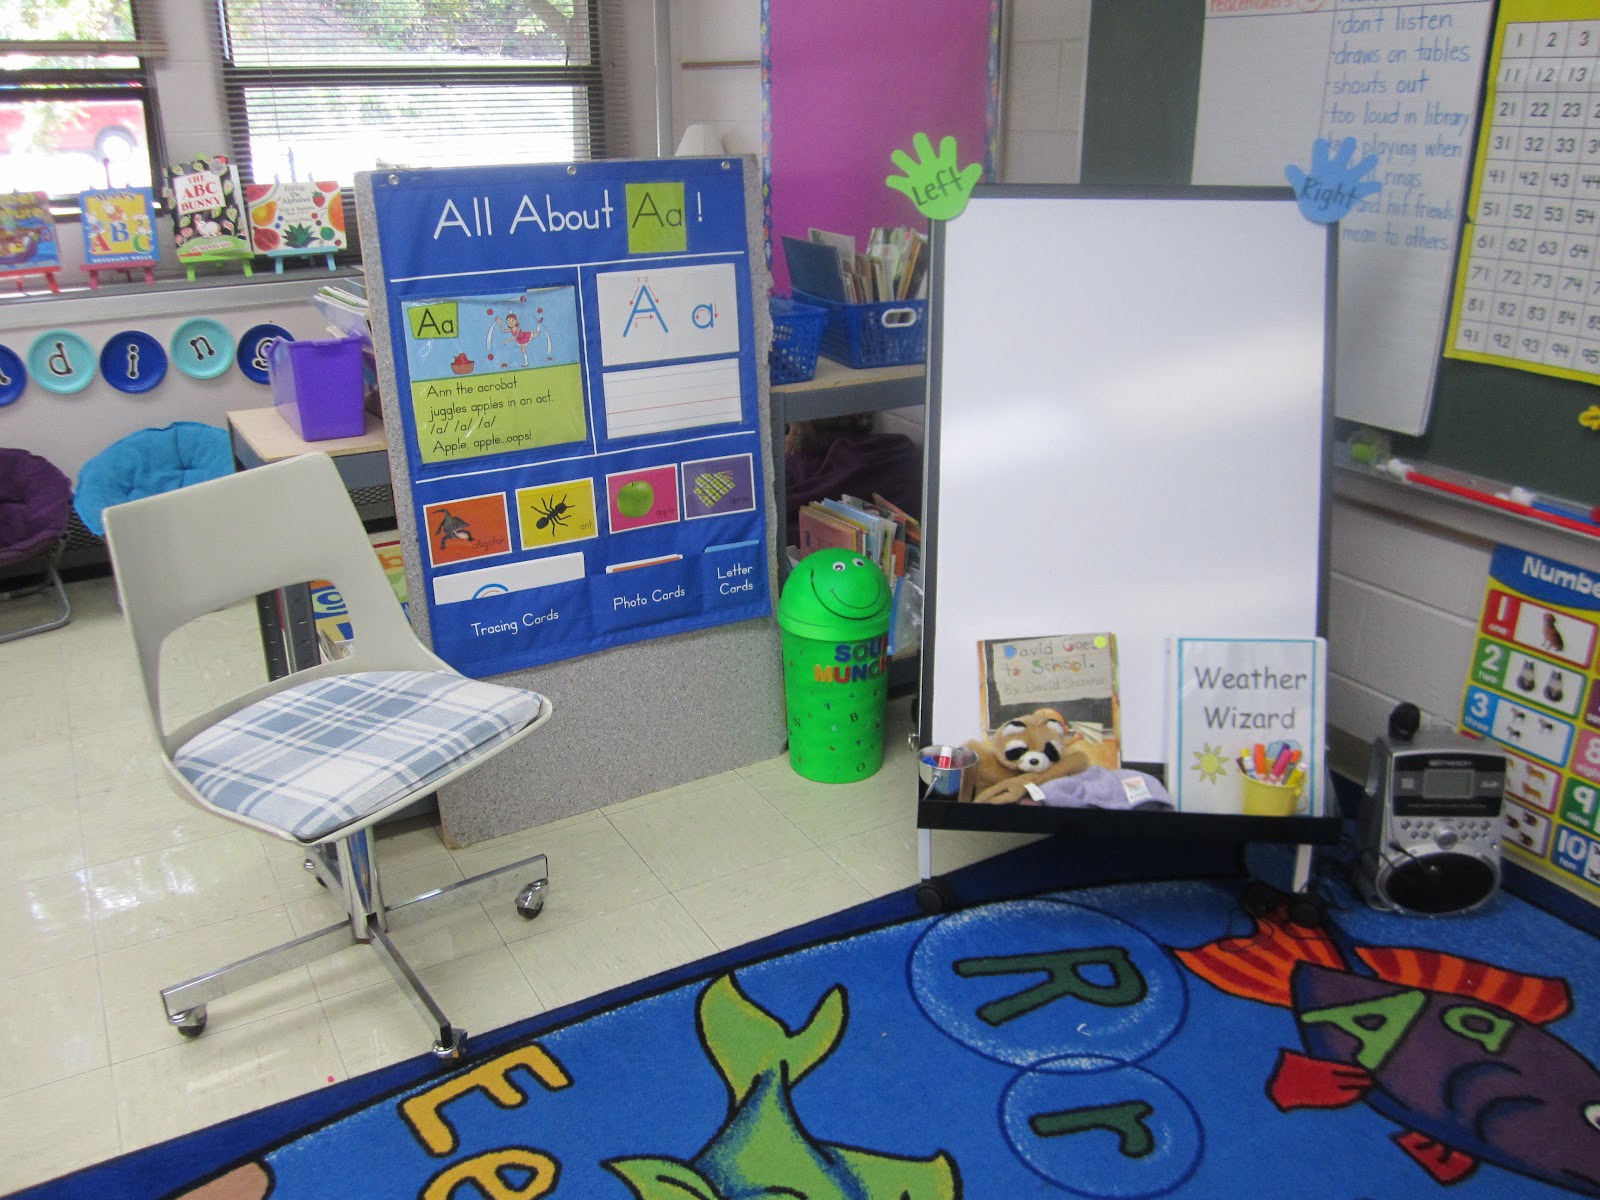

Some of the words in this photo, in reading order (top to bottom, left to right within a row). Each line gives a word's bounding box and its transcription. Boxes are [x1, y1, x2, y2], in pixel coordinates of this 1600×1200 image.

[1395, 6, 1453, 31] listen
[1334, 41, 1380, 64] draws
[1387, 49, 1406, 63] on
[1415, 37, 1470, 62] tables
[1516, 33, 1523, 47] 1
[1546, 32, 1558, 47] 2
[1579, 31, 1590, 46] 3
[1330, 71, 1387, 94] shouts
[1396, 70, 1429, 94] out
[1504, 68, 1520, 82] 11
[1535, 68, 1555, 82] 12
[1568, 68, 1588, 82] 13
[1330, 103, 1355, 124] too
[1363, 101, 1399, 124] loud
[1403, 111, 1416, 124] in
[1425, 101, 1470, 136] library
[1499, 102, 1516, 116] 21
[1530, 102, 1549, 117] 22
[1561, 102, 1581, 117] 23
[1362, 132, 1417, 167] playing
[1425, 133, 1462, 157] when
[1494, 136, 1511, 150] 31
[1524, 137, 1544, 151] 32
[1555, 138, 1575, 152] 33
[183, 181, 217, 199] ABC
[188, 174, 205, 184] THE
[911, 166, 963, 206] Left
[1488, 169, 1506, 183] 41
[1518, 171, 1538, 186] 42
[1549, 173, 1569, 188] 43
[1582, 174, 1600, 189] 44
[181, 197, 222, 211] BUNNY
[1302, 177, 1358, 210] Right
[433, 198, 493, 240] All
[509, 189, 614, 235] About
[632, 191, 683, 229] Aa
[1482, 202, 1500, 216] 51
[1513, 204, 1533, 220] 52
[1544, 207, 1563, 222] 53
[1576, 209, 1595, 224] 54
[1477, 235, 1495, 249] 61
[1507, 239, 1527, 253] 62
[1538, 241, 1558, 255] 63
[1569, 244, 1588, 259] 64
[1471, 266, 1489, 281] 71
[1502, 270, 1521, 285] 72
[1532, 273, 1552, 288] 73
[1563, 277, 1582, 292] 74
[417, 308, 454, 337] Aa
[622, 285, 669, 337] A
[691, 303, 715, 330] a
[1467, 299, 1484, 313] 81
[1497, 302, 1516, 317] 82
[1527, 306, 1545, 321] 83
[1557, 311, 1576, 325] 84
[1463, 330, 1480, 343] 91
[1493, 334, 1511, 349] 92
[1522, 338, 1540, 353] 93
[1552, 343, 1569, 358] 94
[1582, 348, 1600, 364] 95
[427, 385, 452, 398] Ann
[456, 382, 474, 395] the
[477, 376, 517, 393] acrobat
[429, 402, 467, 422] juggles
[471, 397, 504, 416] apples
[508, 397, 516, 407] in
[520, 397, 532, 405] an
[536, 390, 554, 403] act.
[656, 506, 676, 518] apple
[580, 522, 593, 532] ant
[471, 536, 505, 551] alligator
[717, 563, 753, 579] Letter
[613, 592, 647, 610] Photo
[651, 585, 686, 602] Cards
[719, 580, 753, 595] Cards
[1496, 595, 1508, 621] 1
[471, 619, 518, 637] Tracing
[522, 608, 559, 627] Cards
[1003, 641, 1053, 659] David
[1481, 644, 1502, 672] 2
[1004, 664, 1020, 677] to
[1193, 665, 1307, 690] Weather
[1203, 706, 1296, 729] Wizard
[1471, 692, 1490, 718] 3
[1465, 715, 1489, 732] three
[1584, 738, 1600, 764] 8
[1573, 786, 1594, 814] 9
[1557, 829, 1588, 861] 10
